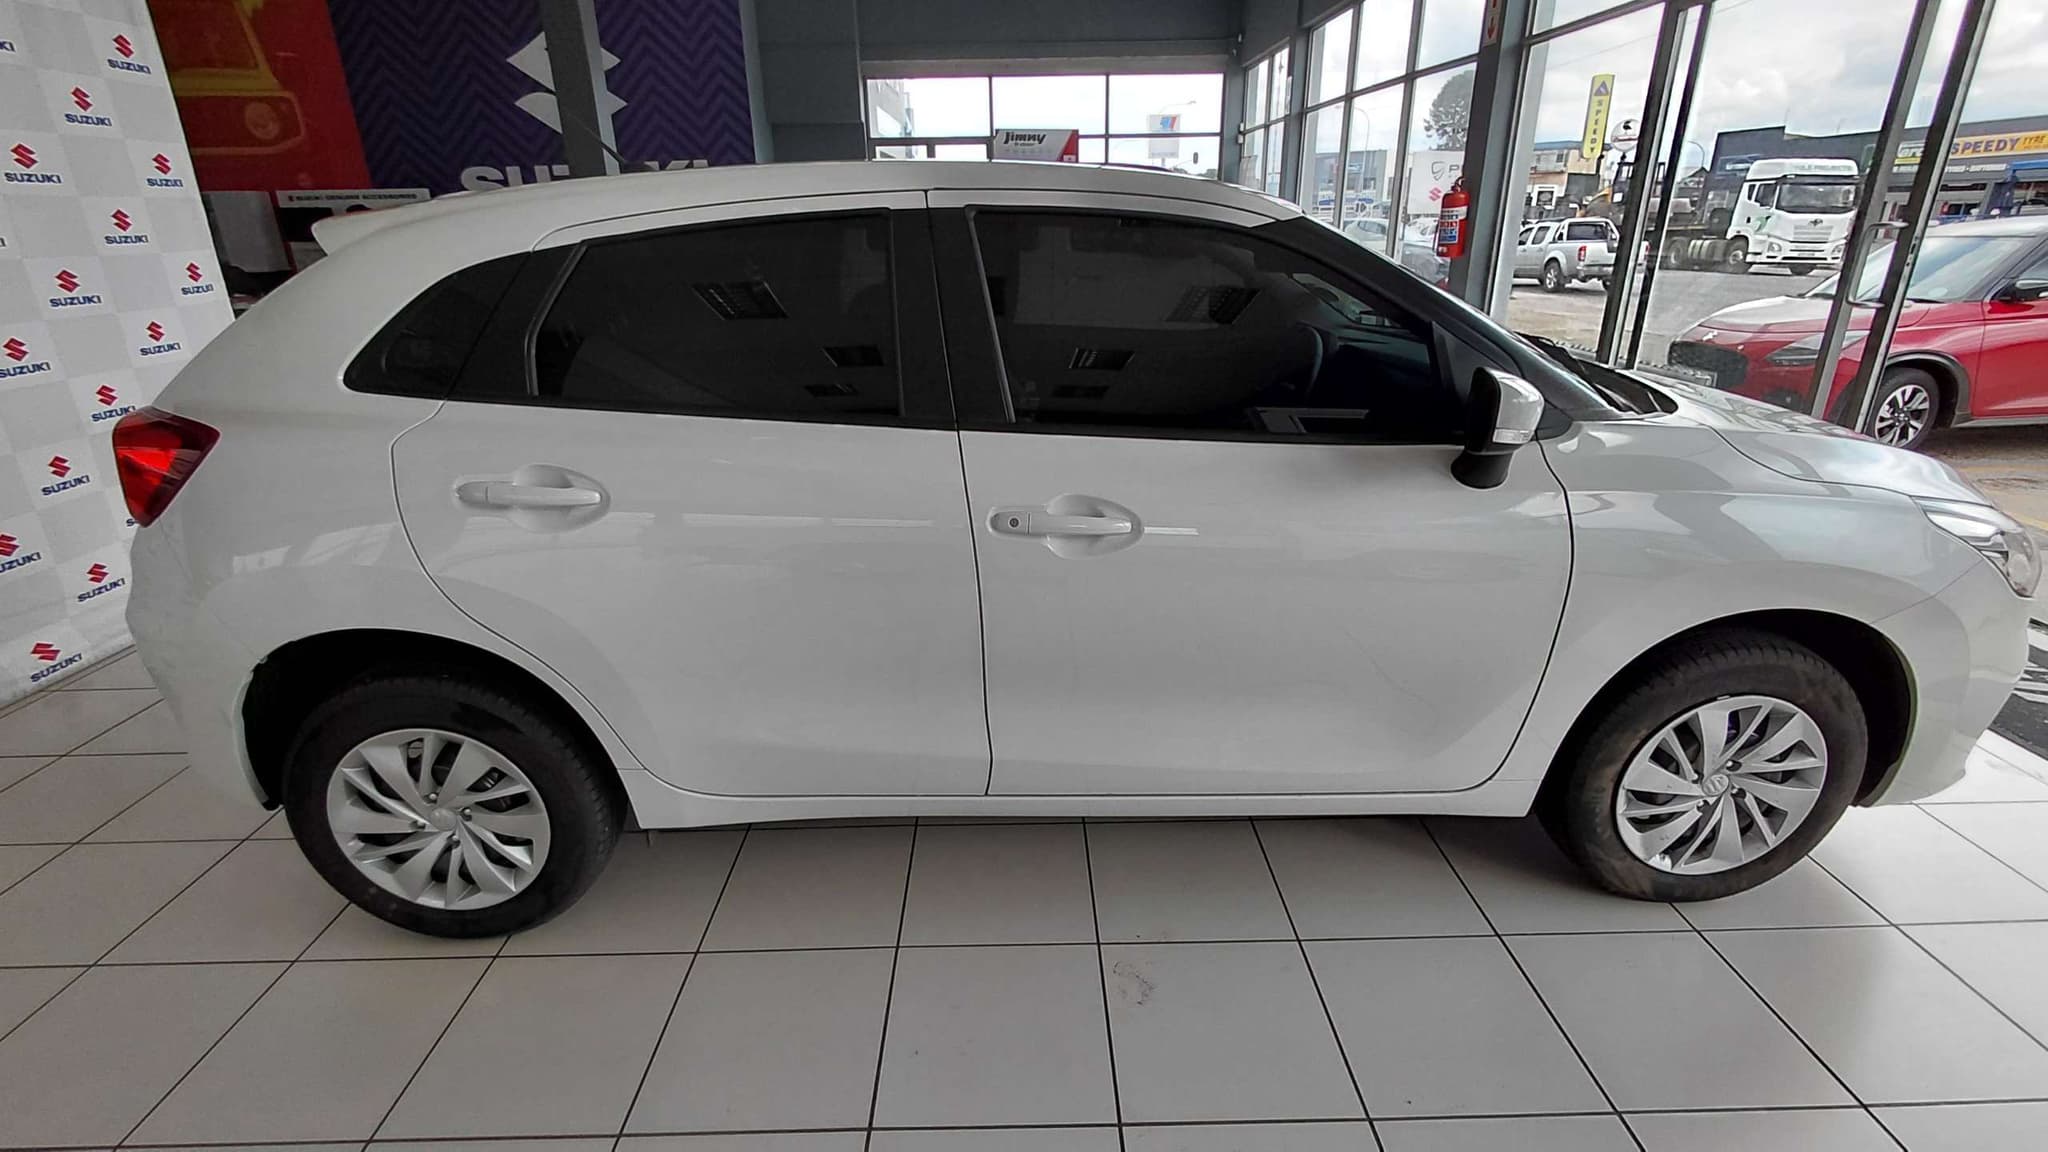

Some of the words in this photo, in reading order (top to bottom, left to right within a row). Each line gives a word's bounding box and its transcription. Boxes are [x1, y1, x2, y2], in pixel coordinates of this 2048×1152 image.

[106, 58, 152, 75] SUZUKI
[64, 113, 113, 127] SUZUKI
[1003, 132, 1046, 144] Jimny
[1951, 138, 2020, 154] SPEEDY
[4, 172, 62, 184] SUZUKI
[146, 177, 184, 188] SUZUKI
[104, 234, 149, 245] SUZUKI
[181, 283, 214, 296] SUZUKI
[49, 295, 102, 308] SUZUKI
[139, 342, 181, 356] SUZUKI
[0, 361, 51, 378] SUZUKI
[91, 405, 136, 422] SUZUKI
[41, 474, 91, 496] SUZUKI
[77, 577, 126, 603] SUZUKI
[30, 652, 83, 683] SUZUKI
